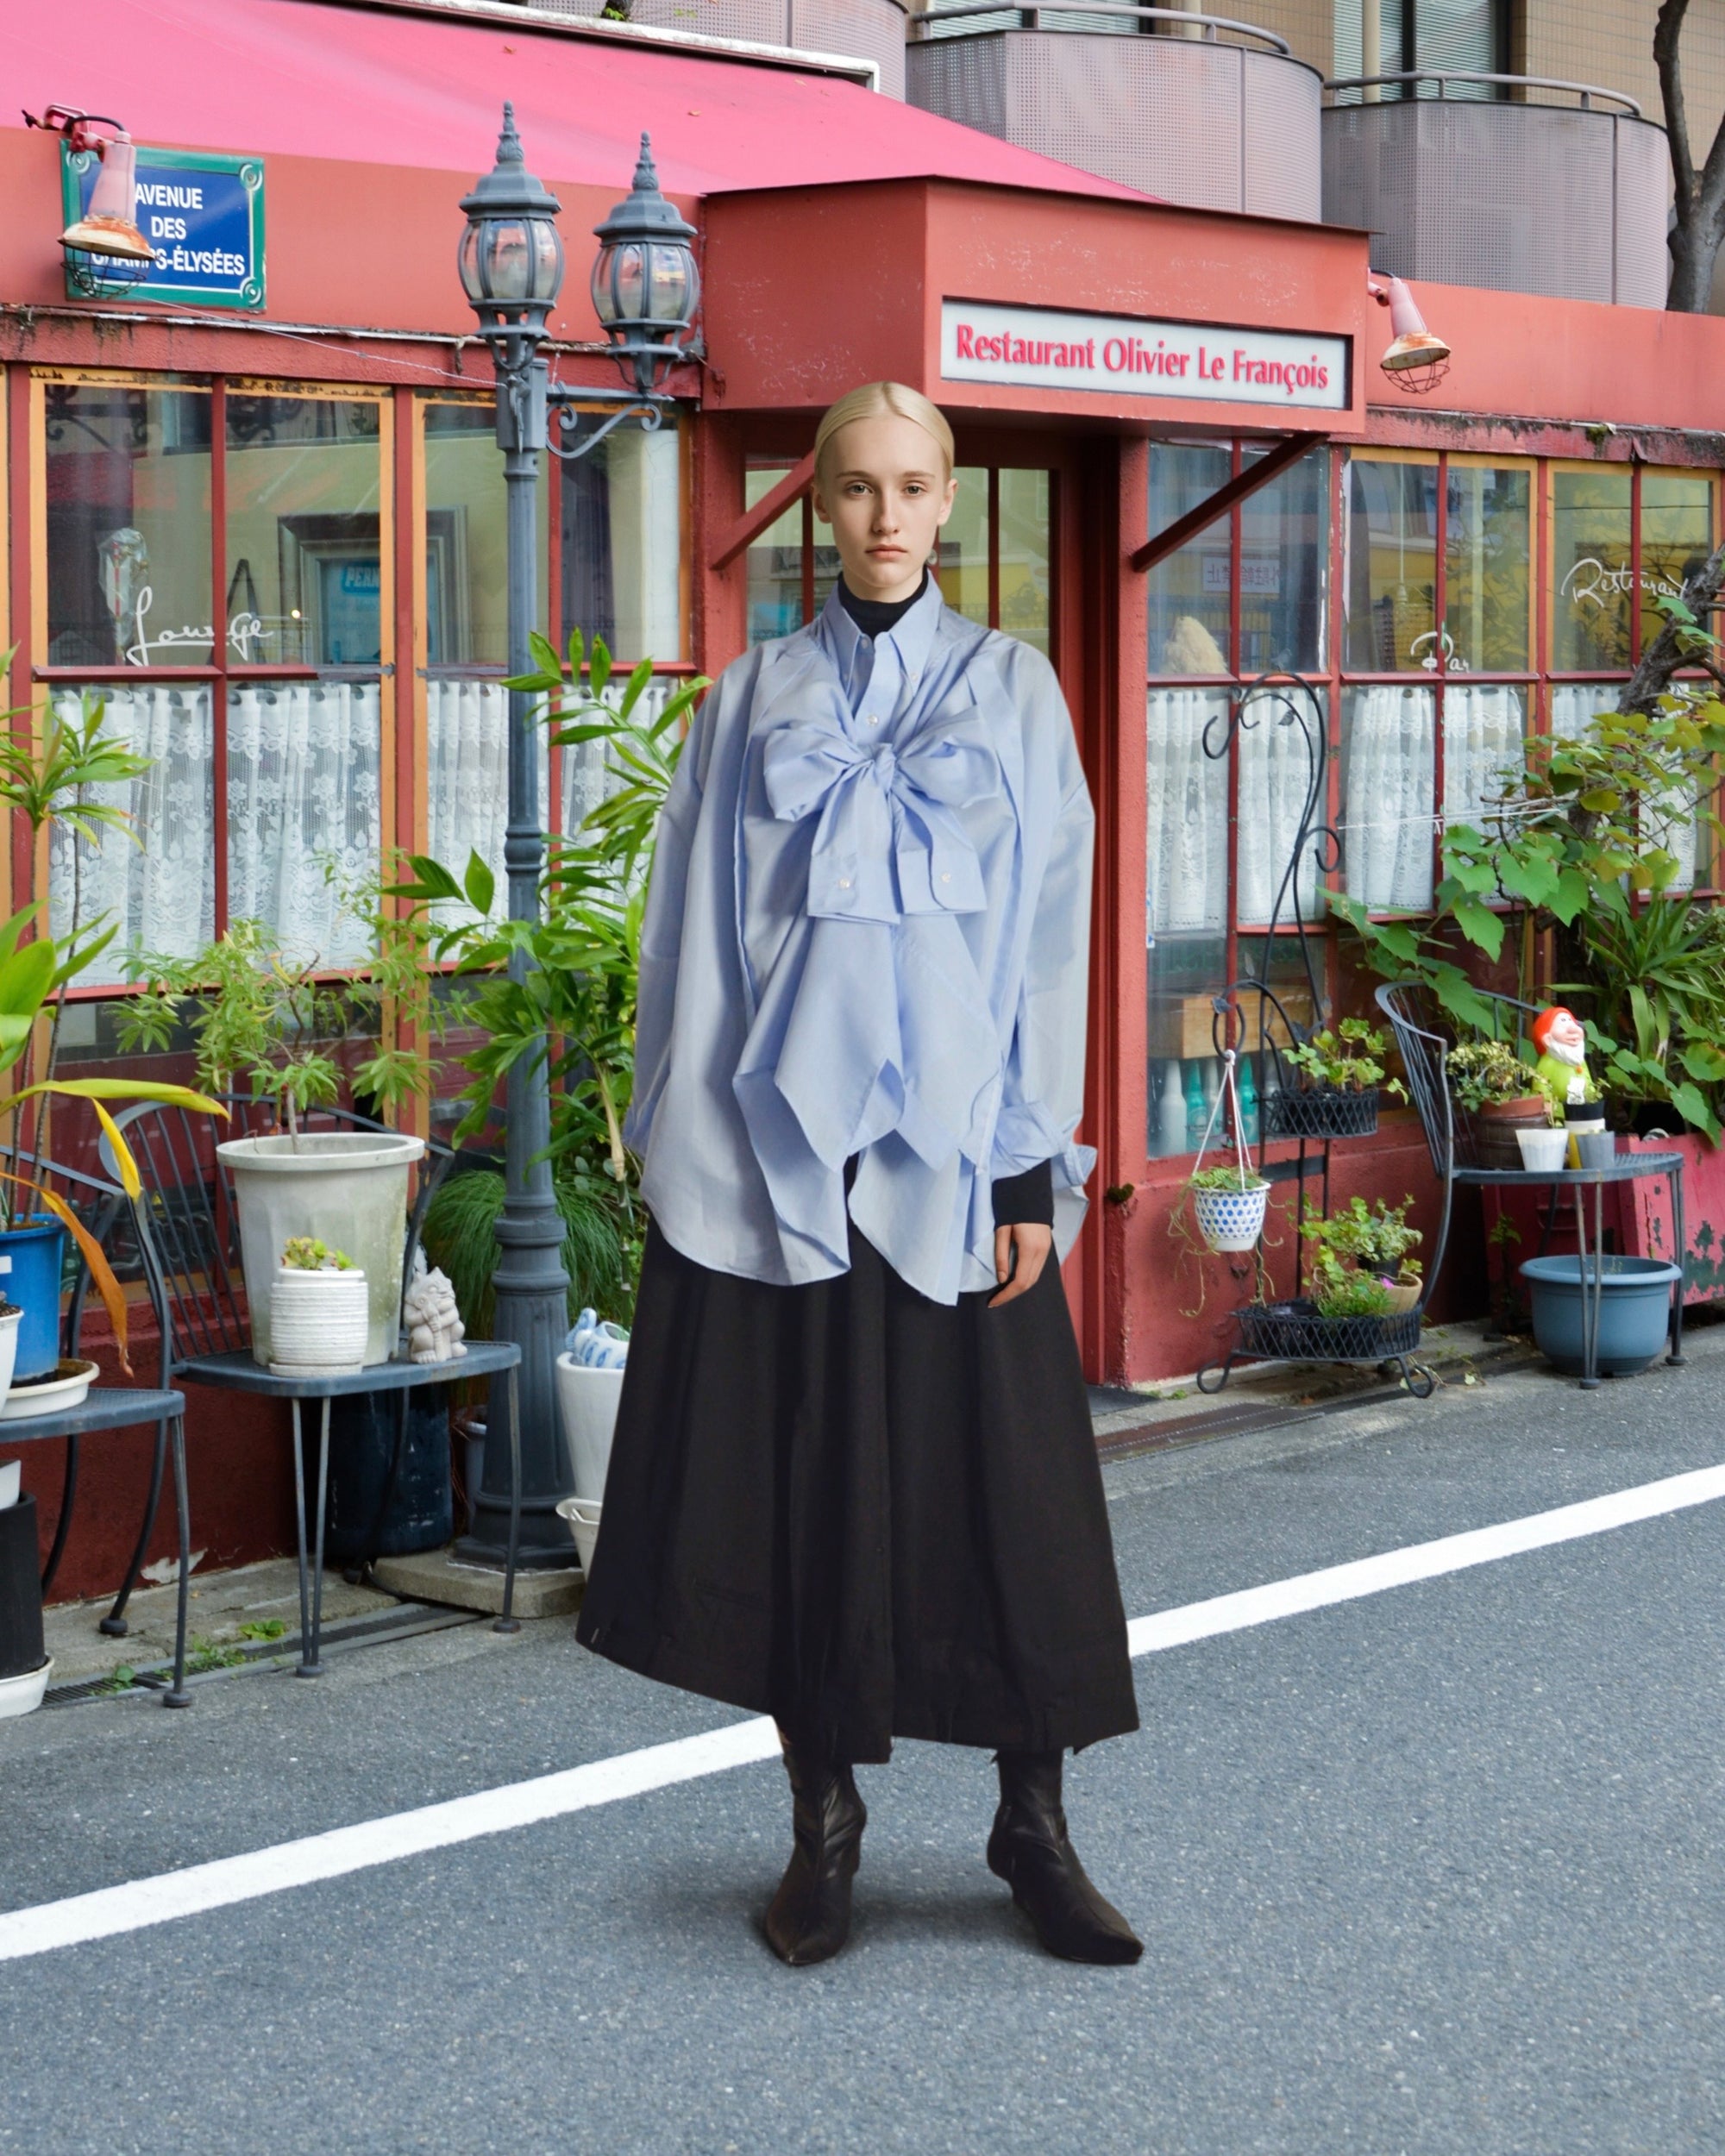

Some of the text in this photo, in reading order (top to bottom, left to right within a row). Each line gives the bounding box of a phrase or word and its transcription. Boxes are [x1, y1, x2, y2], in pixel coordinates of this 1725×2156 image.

[135, 183, 203, 210] AVENUE
[151, 216, 186, 240] DES
[957, 324, 1328, 395] Restaurant Olivier Le François
